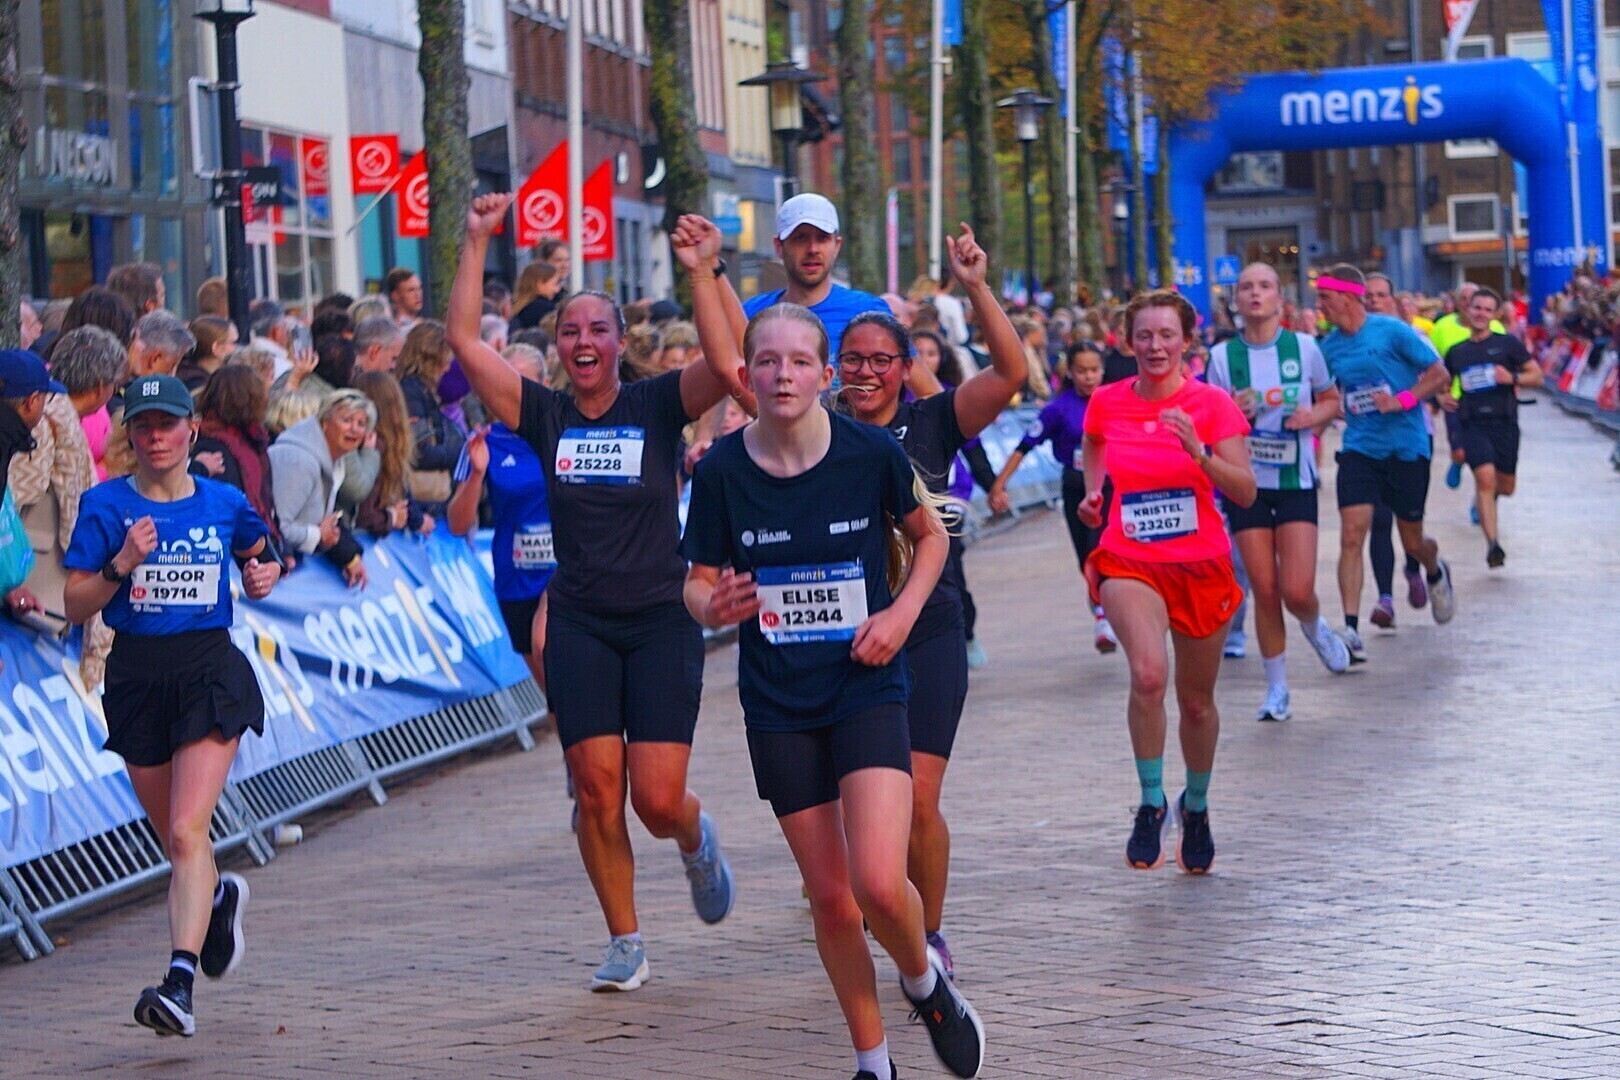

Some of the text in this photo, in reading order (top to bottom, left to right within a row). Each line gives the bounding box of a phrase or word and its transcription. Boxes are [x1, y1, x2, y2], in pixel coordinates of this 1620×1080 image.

[1280, 75, 1444, 126] menzis
[586, 428, 617, 439] menzis
[575, 443, 623, 455] ELISA
[573, 458, 622, 471] 25228
[1133, 503, 1184, 517] KRISTEL
[1138, 517, 1181, 532] 23267
[158, 552, 193, 565] menzis
[145, 570, 205, 583] FLOOR
[791, 568, 827, 582] menzis
[151, 587, 198, 600] 19714
[782, 588, 840, 605] ELISE
[303, 545, 464, 697] menzis
[782, 607, 843, 626] 12344
